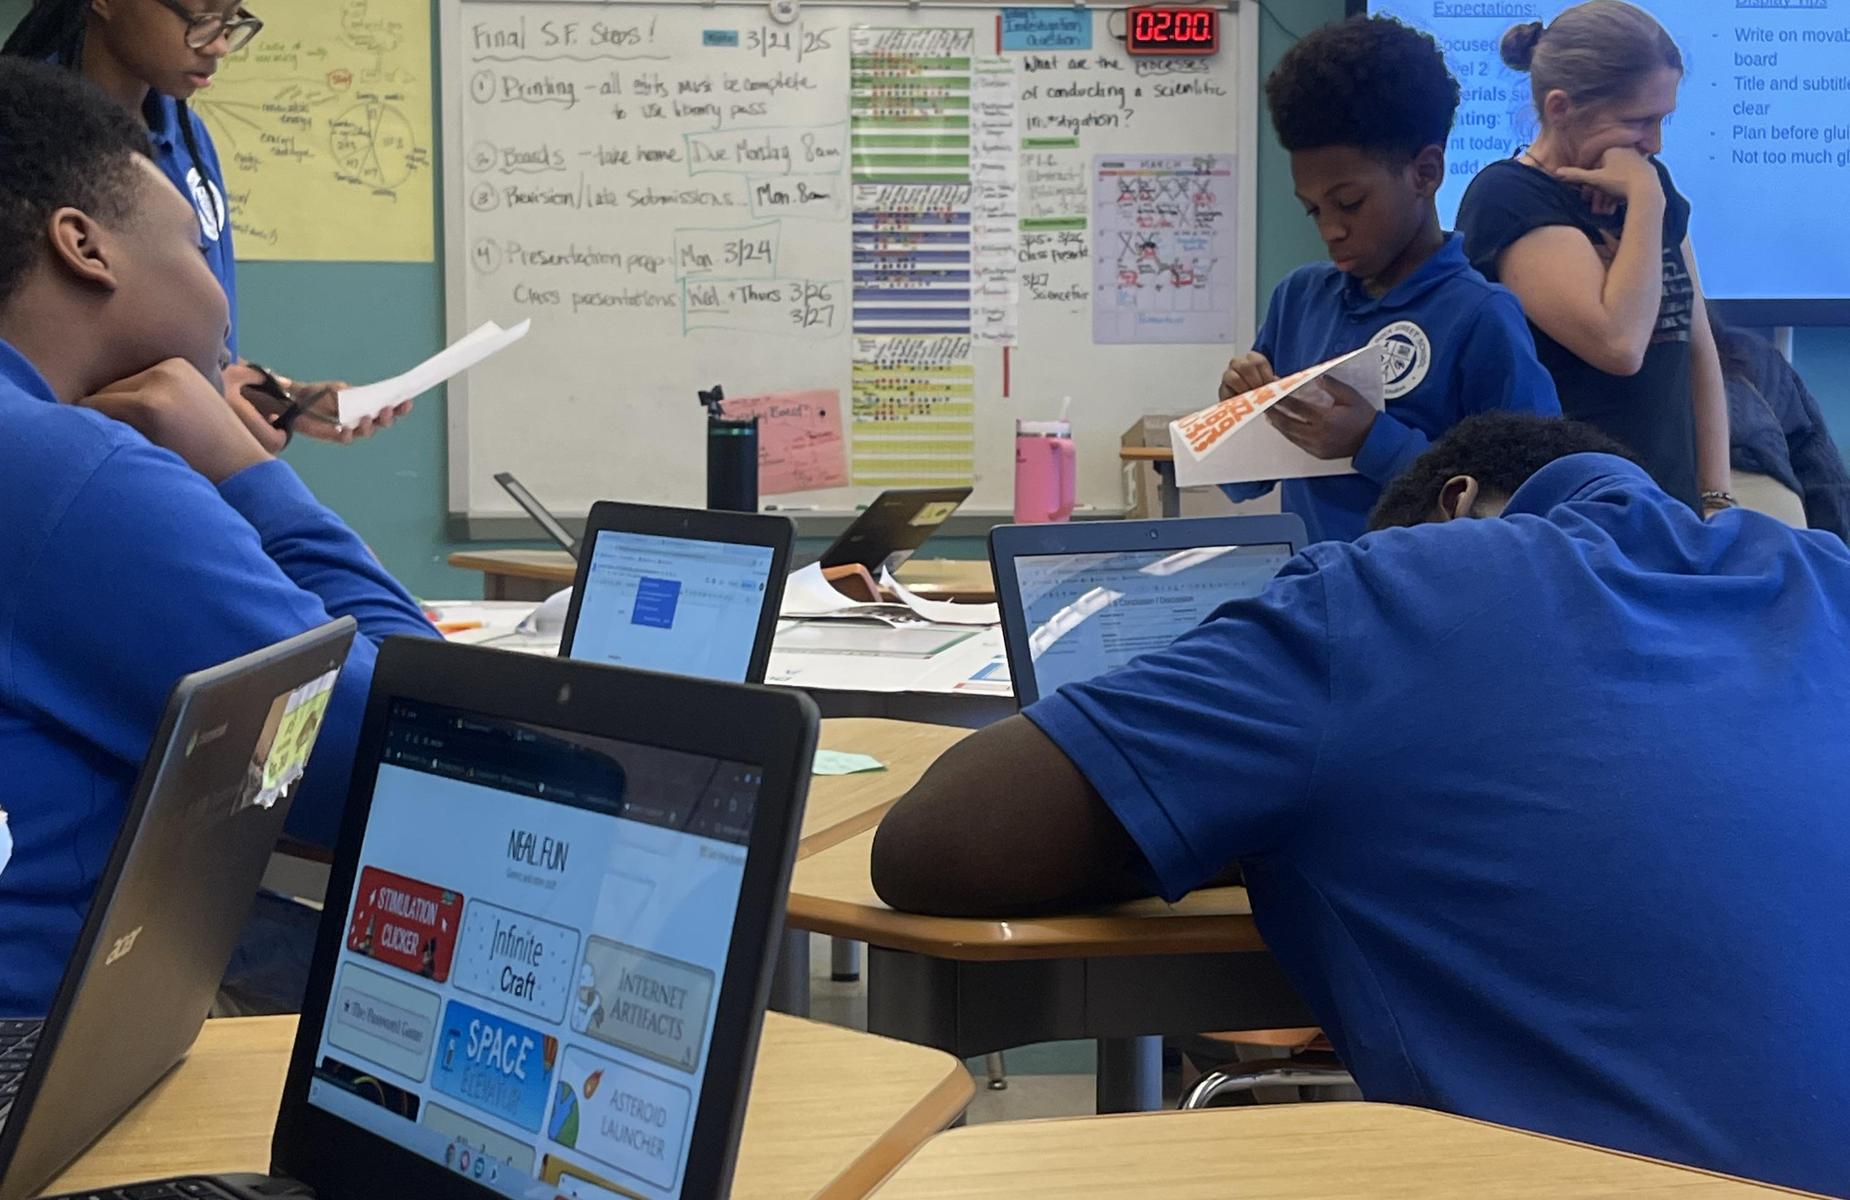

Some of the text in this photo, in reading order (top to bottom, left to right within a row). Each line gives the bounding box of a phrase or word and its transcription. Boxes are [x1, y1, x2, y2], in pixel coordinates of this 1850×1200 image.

[472, 16, 525, 49] Final
[747, 22, 838, 63] 3/21/25
[1735, 27, 1774, 42] Write
[1779, 30, 1798, 42] on
[1024, 57, 1058, 73] What
[1098, 58, 1126, 71] the
[1479, 61, 1488, 76] 2
[1734, 52, 1778, 67] board
[502, 75, 577, 110] Printing
[600, 72, 622, 94] all
[743, 72, 818, 96] complete
[1022, 84, 1039, 101] of
[1046, 82, 1126, 109] conducting
[1154, 80, 1227, 97] scientific
[1734, 75, 1765, 91] Title
[1770, 75, 1798, 91] and
[1733, 101, 1770, 116] clear
[1470, 136, 1512, 154] today
[1732, 125, 1766, 140] Plan
[1771, 125, 1819, 140] before
[1732, 150, 1759, 164] Not
[1763, 150, 1787, 164] too
[1791, 149, 1832, 164] much
[724, 238, 772, 267] 3/24
[513, 284, 561, 306] Class
[737, 284, 782, 303] Thurs
[788, 279, 833, 306] 3/26
[790, 304, 835, 328] 3/27
[377, 886, 440, 928] STIMULATION
[381, 922, 420, 956] CLICKER
[491, 919, 543, 967] Infinite
[501, 966, 536, 1001] Craft
[617, 966, 690, 1011] INTERNET
[609, 998, 683, 1041] ARTIFACTS
[467, 1018, 535, 1080] SPACE
[609, 1089, 668, 1129] ASTEROID
[600, 1116, 667, 1161] LAUNCHER
